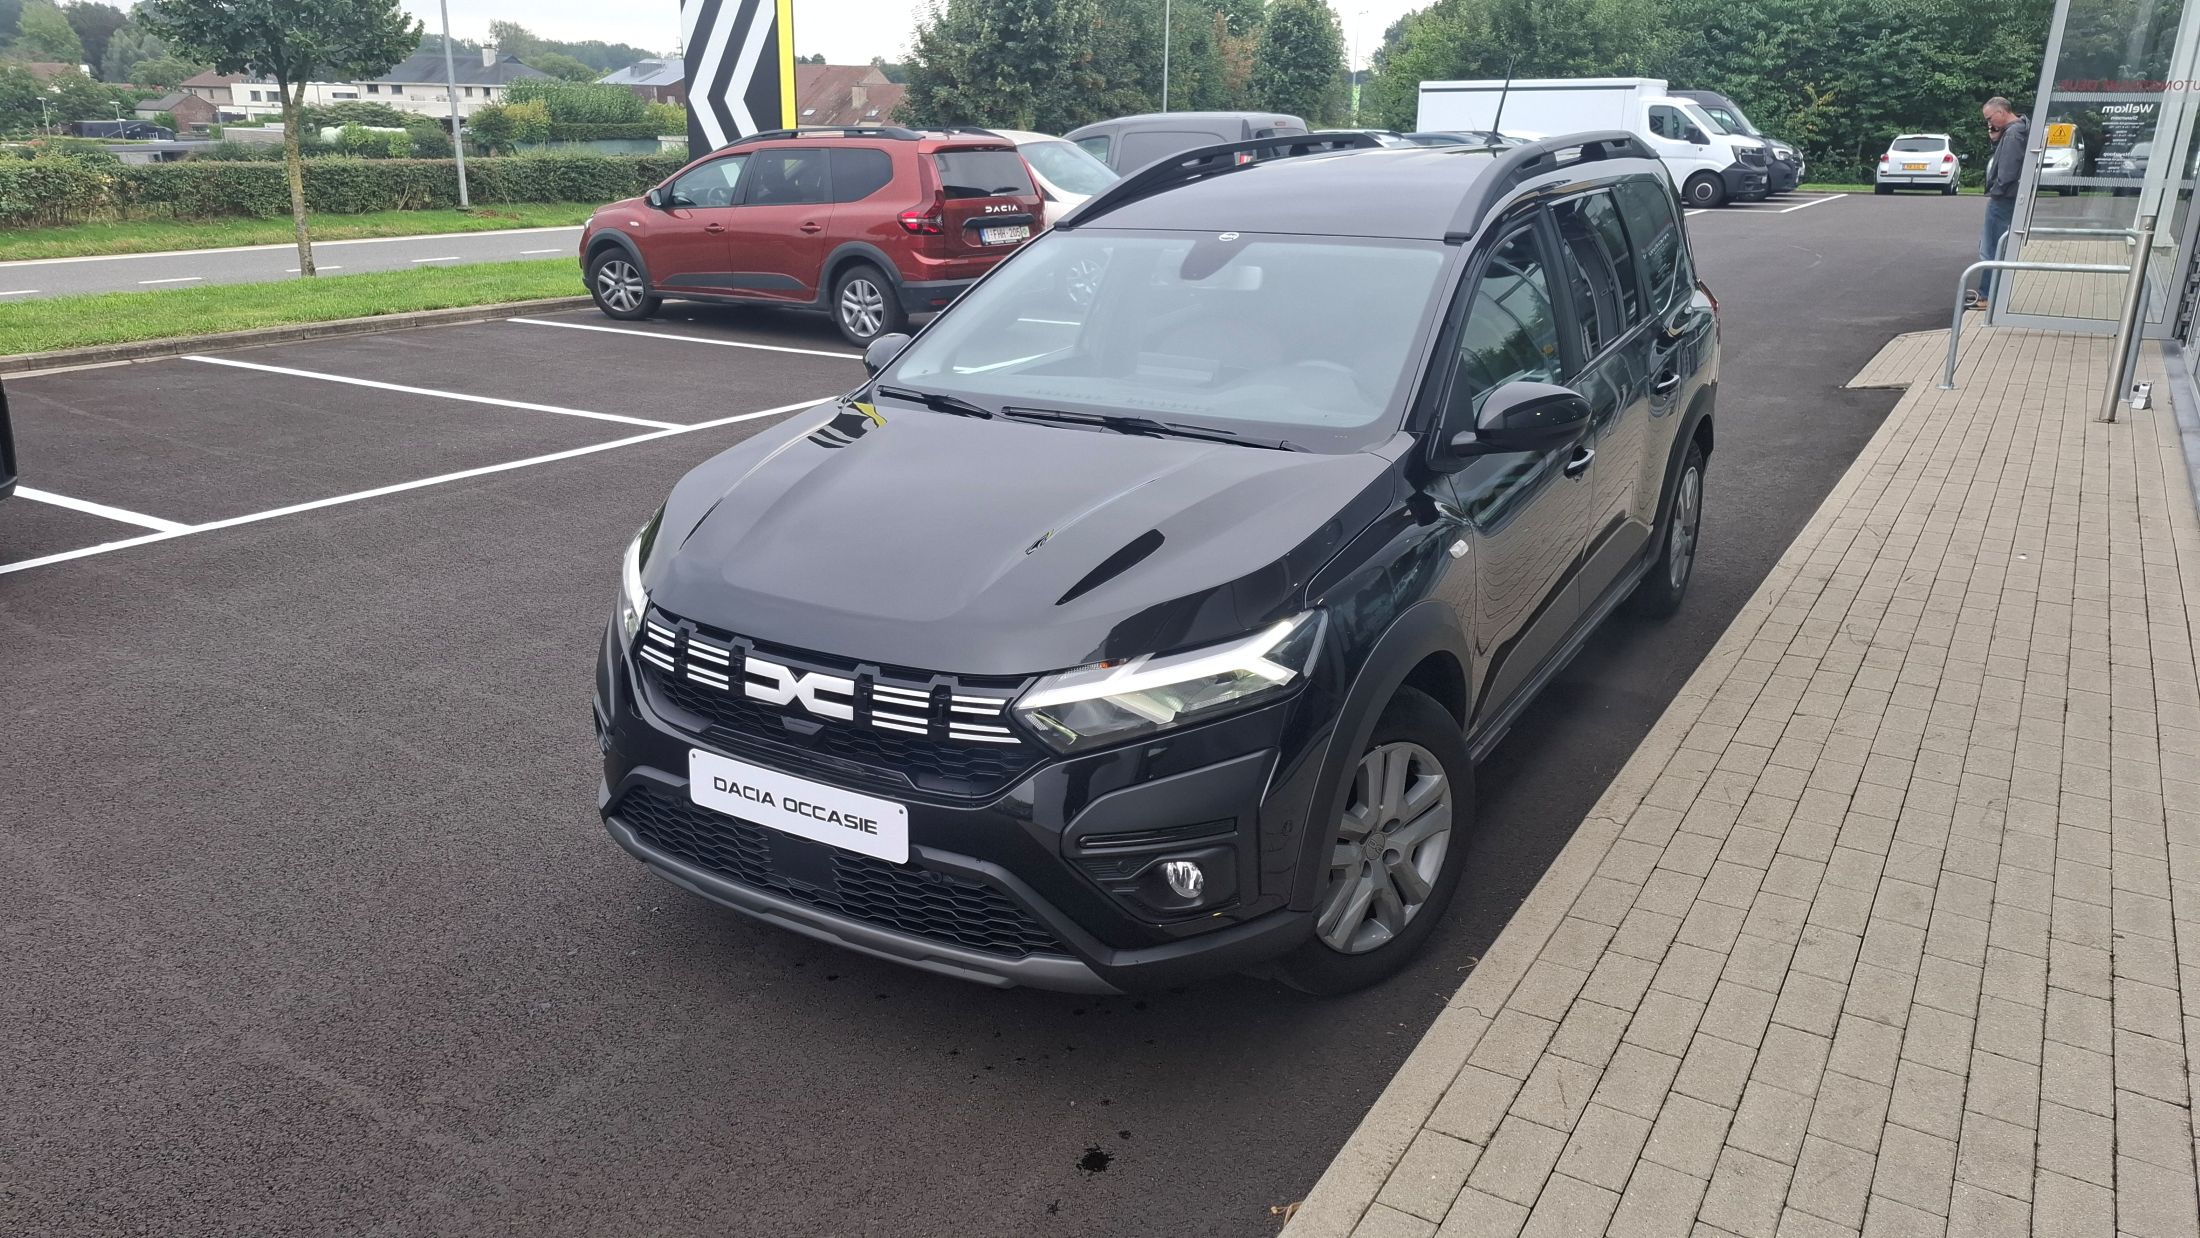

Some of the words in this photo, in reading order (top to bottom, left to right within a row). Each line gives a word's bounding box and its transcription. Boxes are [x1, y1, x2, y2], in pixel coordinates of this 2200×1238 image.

[985, 204, 1018, 213] DACIA
[713, 776, 776, 808] DACIA
[783, 797, 878, 836] OCCASIE
